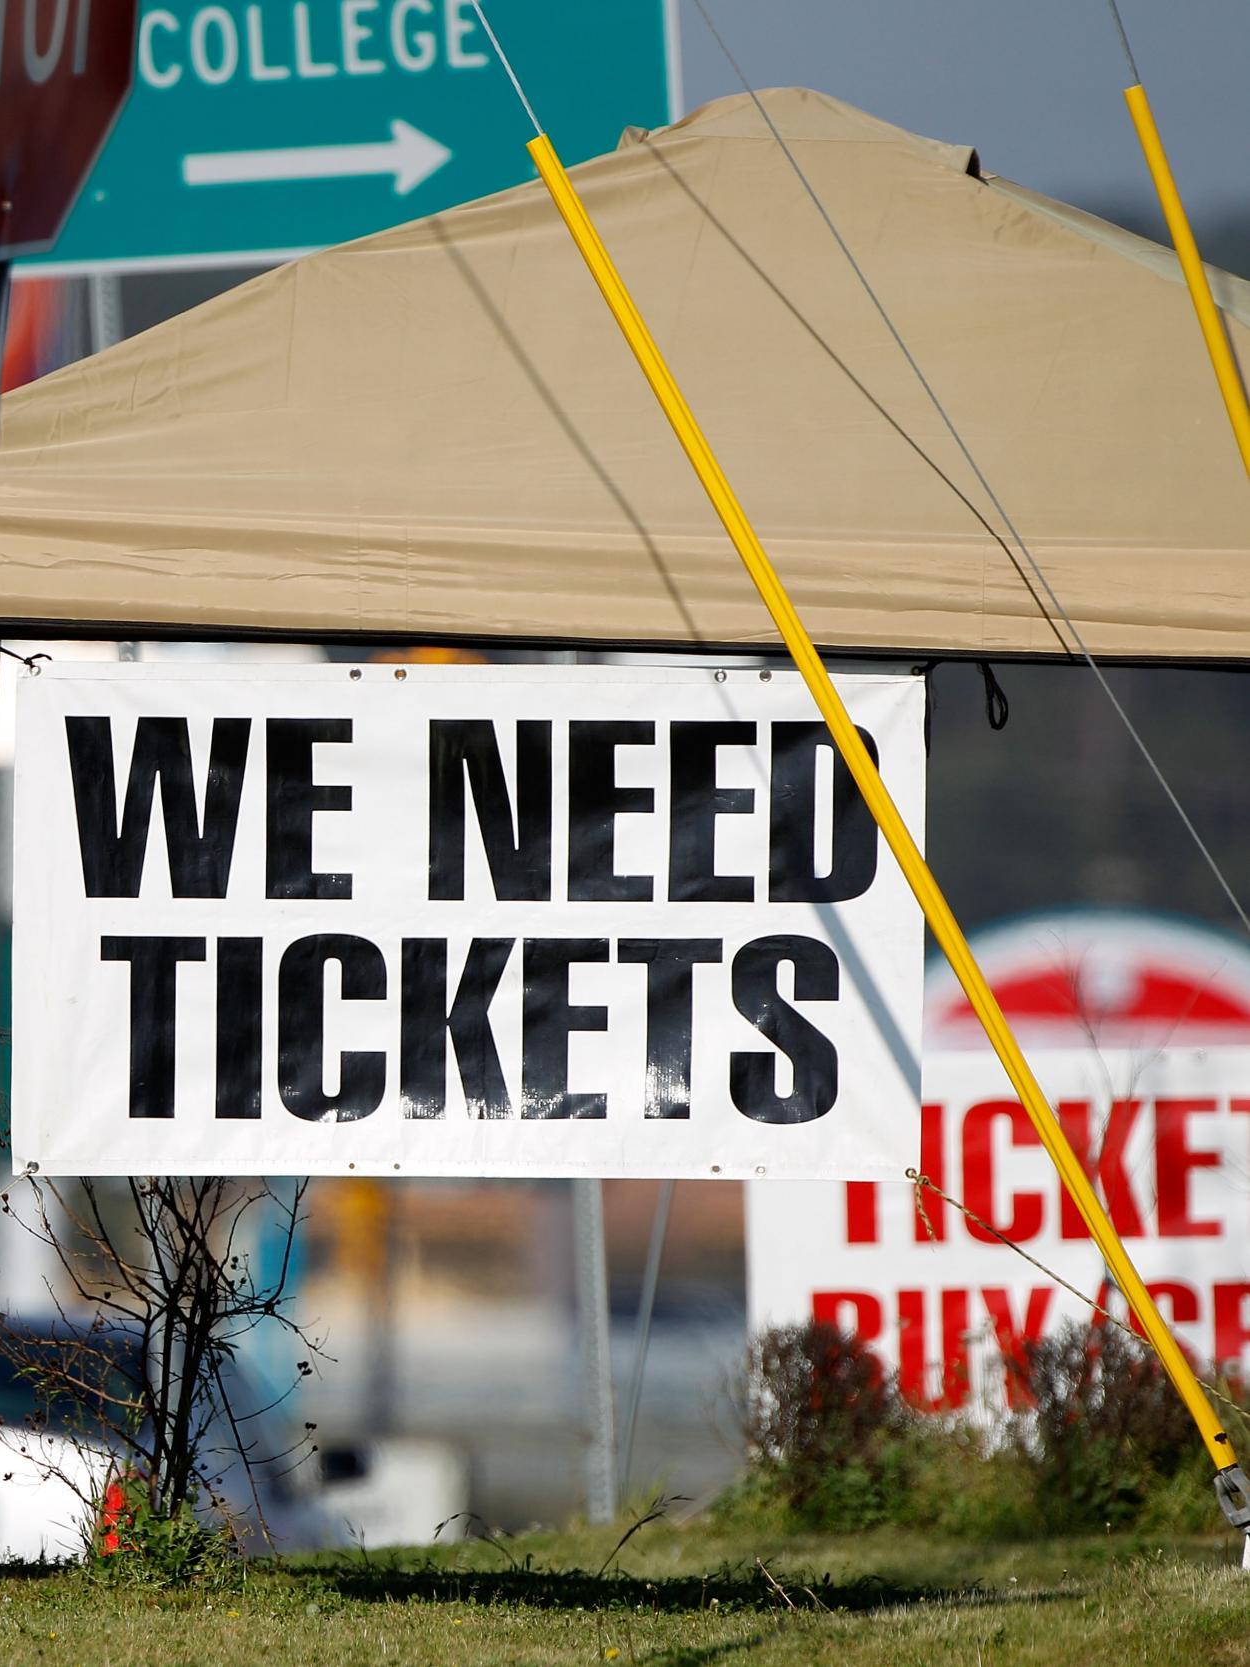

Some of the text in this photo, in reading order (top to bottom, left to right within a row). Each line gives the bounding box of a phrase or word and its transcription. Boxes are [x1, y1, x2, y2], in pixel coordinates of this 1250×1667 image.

[139, 0, 490, 89] COLLEGE
[64, 715, 881, 903] WE NEED
[100, 933, 841, 1126] TICKETS
[844, 1097, 1250, 1246] ICKE
